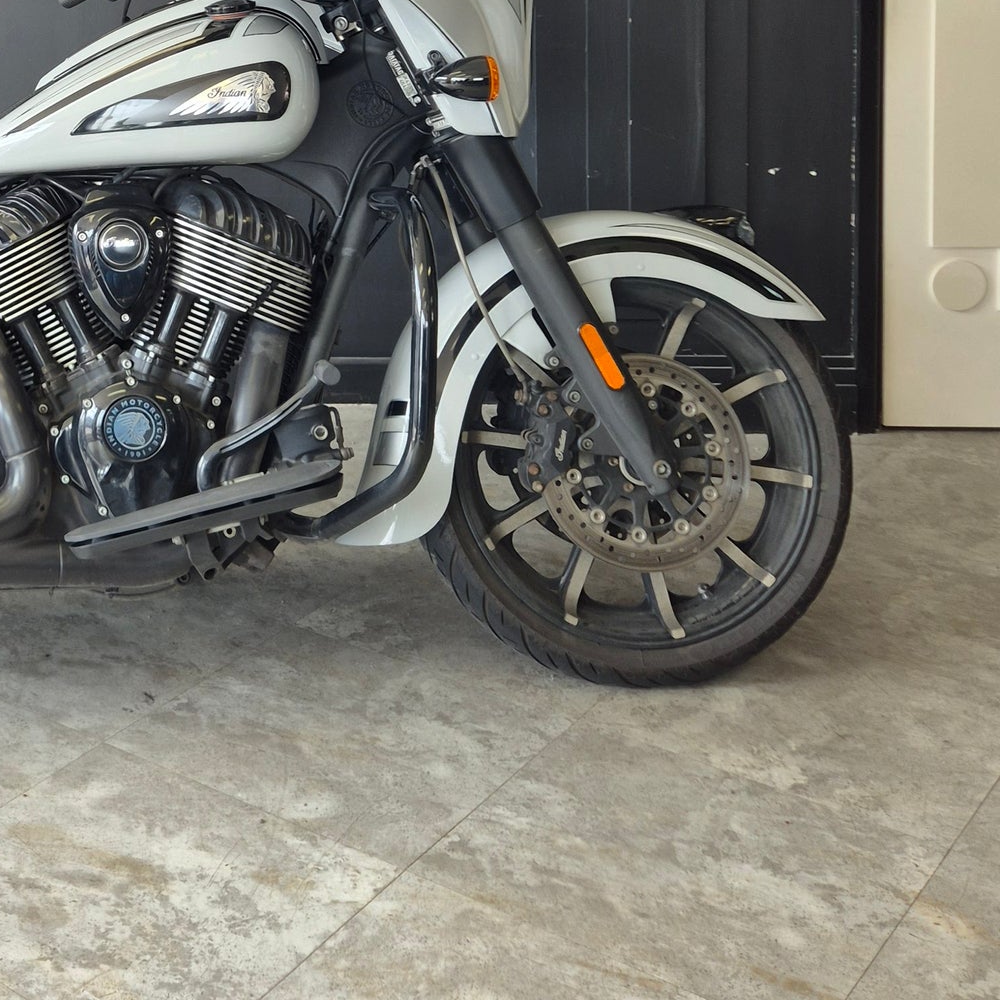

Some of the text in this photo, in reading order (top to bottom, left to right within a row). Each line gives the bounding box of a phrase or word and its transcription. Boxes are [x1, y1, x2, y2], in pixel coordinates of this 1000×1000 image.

[207, 86, 247, 99] Indian
[106, 399, 163, 447] INDIAN MOTORCYCLE
[124, 449, 146, 457] 1901
